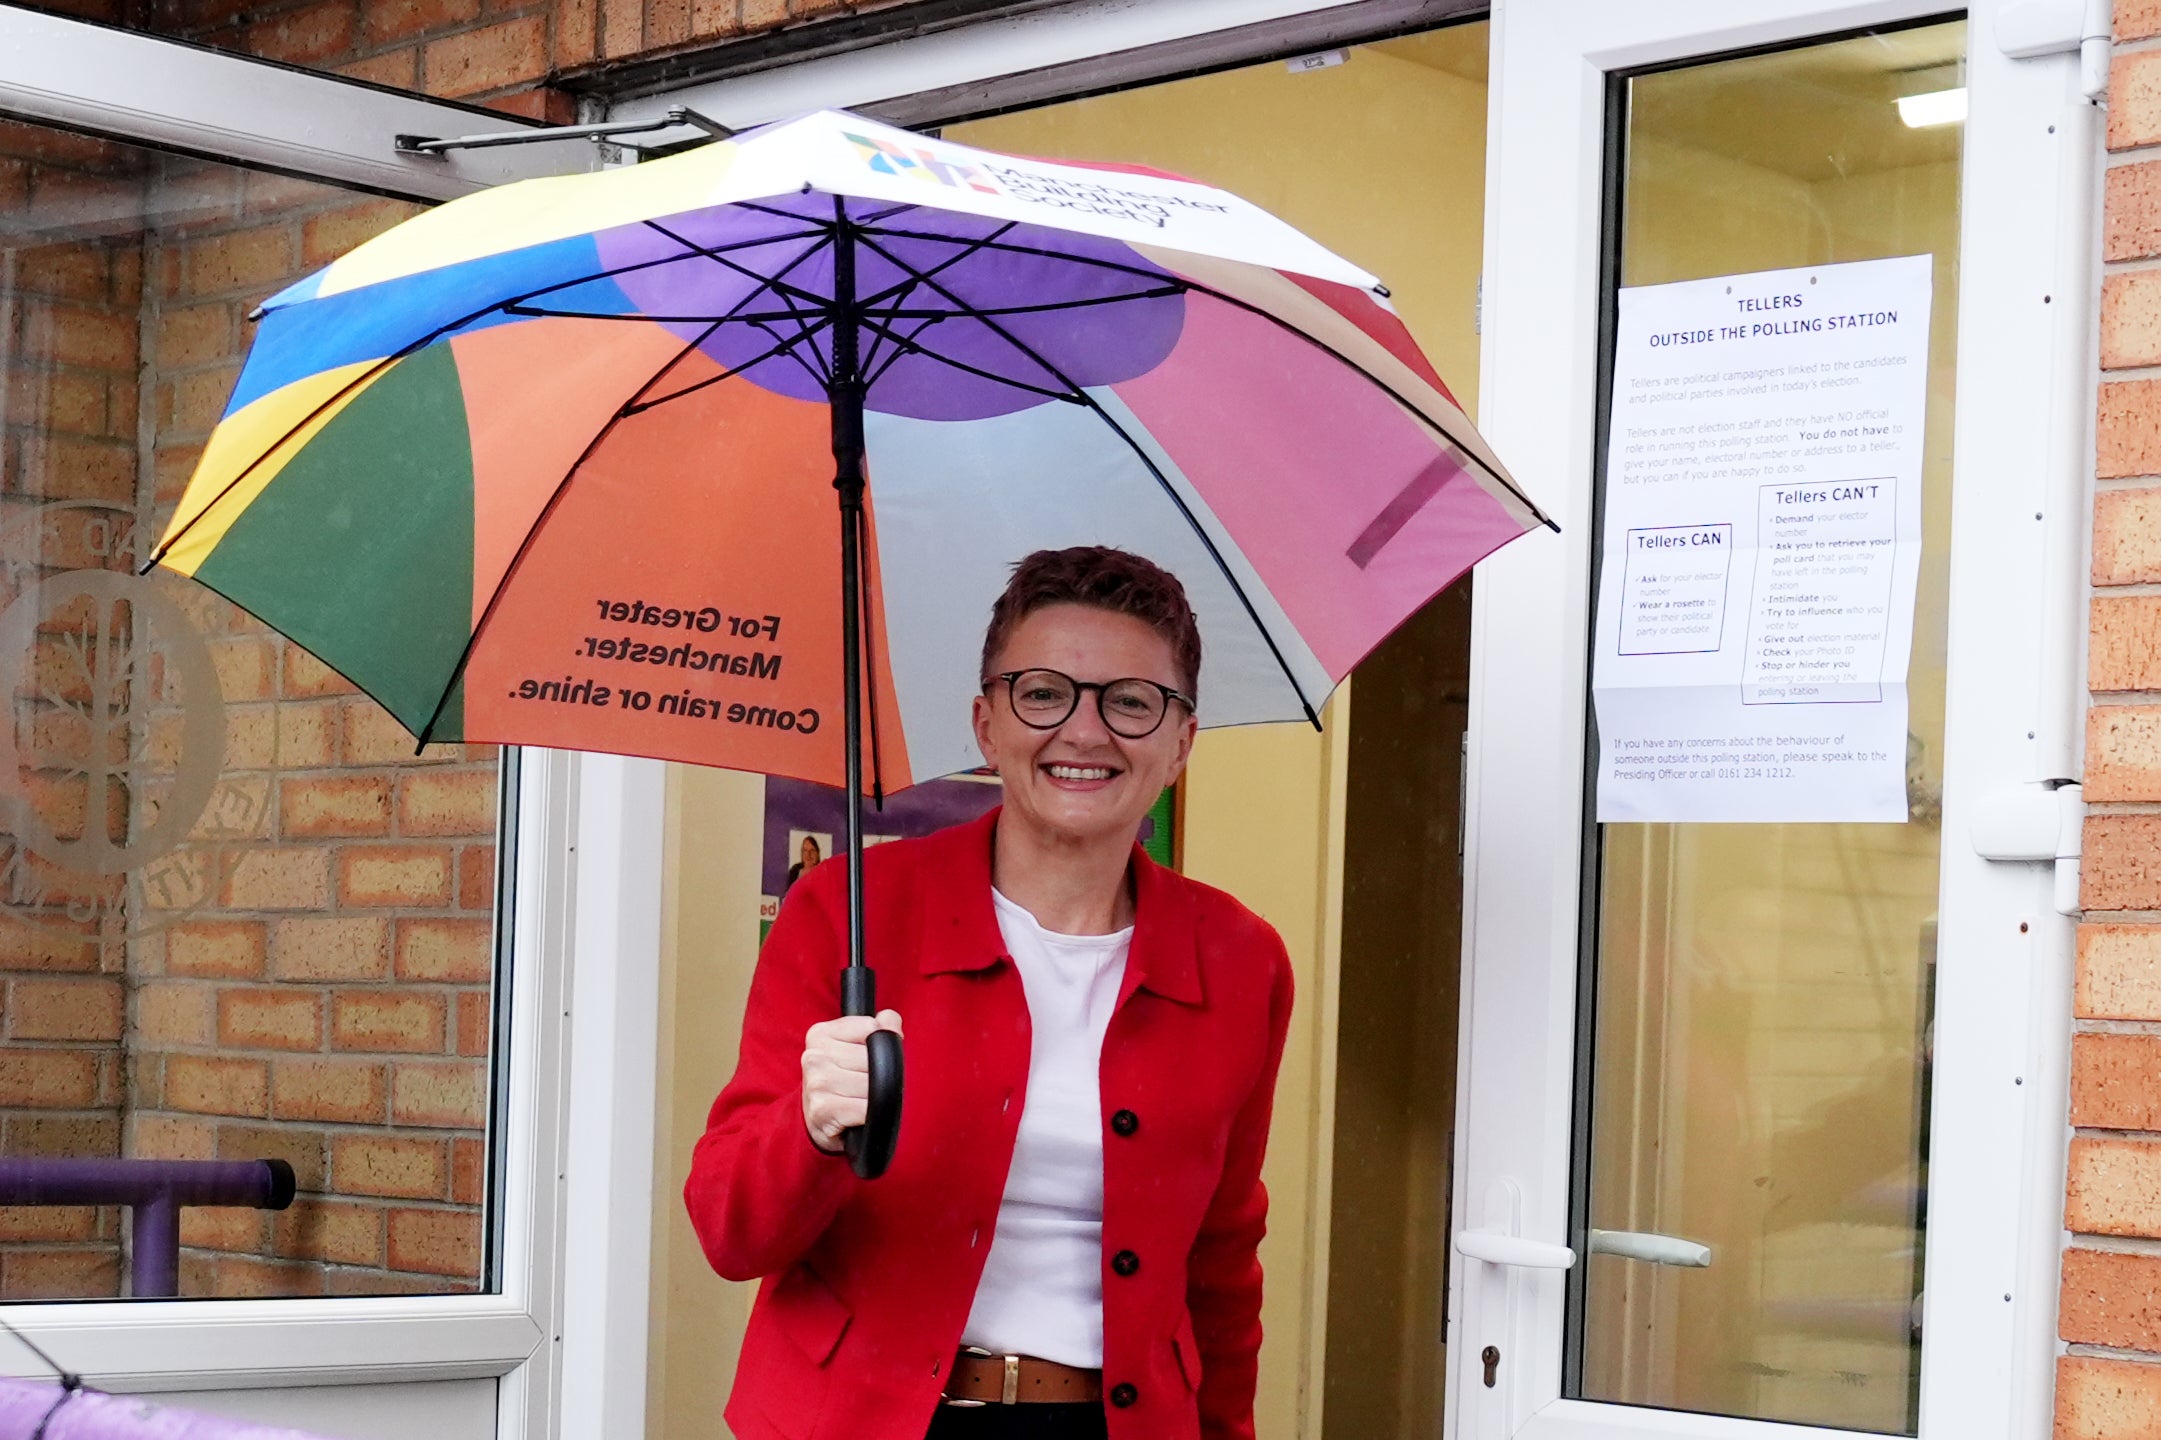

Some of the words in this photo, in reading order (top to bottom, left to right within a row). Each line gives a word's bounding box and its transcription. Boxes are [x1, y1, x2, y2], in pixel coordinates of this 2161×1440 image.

[980, 163, 1228, 214] Manchester
[995, 174, 1170, 217] Building
[1008, 188, 1165, 228] Society
[1737, 294, 1803, 313] TELLERS
[1650, 328, 1715, 347] OUTSIDE
[1720, 325, 1747, 341] THE
[1752, 318, 1822, 337] POLLING
[1827, 311, 1898, 330] STATION
[1630, 378, 1661, 388] Tellers
[1664, 377, 1680, 386] are
[1682, 372, 1719, 386] political
[1722, 367, 1784, 381] campaigners
[1788, 363, 1818, 374] linked
[1820, 363, 1831, 372] to
[1834, 361, 1850, 370] the
[1853, 356, 1908, 369] candidates
[1629, 393, 1646, 404] and
[1650, 390, 1687, 404] political
[1690, 388, 1723, 401] parties
[1727, 383, 1767, 396] involved
[1771, 383, 1779, 392] in
[1783, 380, 1817, 391] today's
[1820, 376, 1862, 388] election.
[1626, 428, 1657, 438] Tellers
[1660, 427, 1676, 436] are
[1679, 425, 1695, 434] not
[1698, 422, 1735, 433] election
[1738, 418, 1761, 430] staff
[1763, 417, 1782, 428] and
[1785, 416, 1807, 427] they
[1810, 414, 1834, 424] have
[1837, 411, 1853, 421] NO
[1856, 408, 1889, 420] official
[1625, 443, 1644, 454] role
[1647, 443, 1656, 452] in
[1659, 441, 1695, 452] running
[1698, 438, 1716, 448] this
[1719, 436, 1752, 448] polling
[1800, 431, 1819, 440] You
[1822, 429, 1836, 439] do
[1840, 427, 1859, 437] not
[1862, 425, 1889, 435] have
[1892, 424, 1903, 434] to
[1624, 460, 1644, 471] give
[1648, 459, 1669, 470] your
[1704, 451, 1746, 464] electoral
[1749, 449, 1787, 460] number
[1790, 448, 1801, 457] or
[1804, 445, 1843, 457] address
[1846, 443, 1857, 453] to
[1859, 444, 1866, 452] a
[1623, 474, 1640, 484] but
[1642, 475, 1659, 486] you
[1663, 473, 1679, 481] can
[1682, 470, 1689, 479] if
[1692, 471, 1708, 482] you
[1712, 470, 1727, 478] are
[1731, 466, 1760, 479] happy
[1764, 465, 1774, 474] to
[1777, 463, 1790, 473] do
[1776, 490, 1827, 504] Tellers
[1832, 485, 1879, 501] CAN'T
[1775, 514, 1814, 524] Demand
[1637, 535, 1686, 548] Tellers
[1691, 532, 1721, 546] CAN
[1776, 542, 1792, 550] Ask
[1795, 543, 1813, 551] you
[1815, 541, 1825, 549] to
[1828, 539, 1867, 548] retrieve
[1869, 539, 1892, 547] your
[1773, 555, 1791, 565] poll
[1794, 555, 1814, 563] card
[1817, 553, 1835, 562] that
[1838, 553, 1854, 562] you
[1856, 553, 1875, 562] may
[1641, 575, 1657, 583] Ask
[1639, 601, 1662, 609] Wear
[1672, 600, 1705, 608] rosette
[1769, 594, 1819, 604] Intimidate
[1822, 594, 1838, 603] you
[1768, 608, 1782, 618] Try
[1785, 608, 1795, 616] to
[1798, 607, 1843, 616] influence
[1867, 606, 1883, 615] you
[1764, 635, 1785, 643] Give
[1788, 635, 1804, 643] out
[1762, 648, 1791, 657] Check
[1761, 661, 1782, 670] Stop
[1799, 660, 1830, 669] hinder
[1833, 661, 1850, 669] you
[1758, 688, 1786, 698] polling
[1789, 687, 1819, 696] station
[1614, 738, 1621, 749] If
[1623, 740, 1640, 750] you
[1643, 738, 1664, 748] have
[1667, 739, 1683, 749] any
[1686, 738, 1726, 747] concerns
[1728, 737, 1754, 747] about
[1756, 736, 1773, 746] the
[1776, 735, 1830, 746] behaviour
[1833, 733, 1844, 745] of
[1614, 755, 1655, 764] someone
[1657, 753, 1689, 763] outside
[1692, 752, 1708, 763] this
[1711, 752, 1740, 765] polling
[1742, 752, 1779, 764] station,
[1783, 751, 1818, 763] please
[1821, 751, 1854, 763] speak
[1857, 751, 1868, 761] to
[1871, 750, 1887, 761] the
[1614, 769, 1655, 781] Presiding
[1658, 768, 1687, 779] Officer
[1689, 770, 1698, 779] or
[1700, 768, 1715, 779] call
[1718, 768, 1740, 779] 0161
[1744, 767, 1762, 778] 234
[1766, 767, 1795, 778] 1212.
